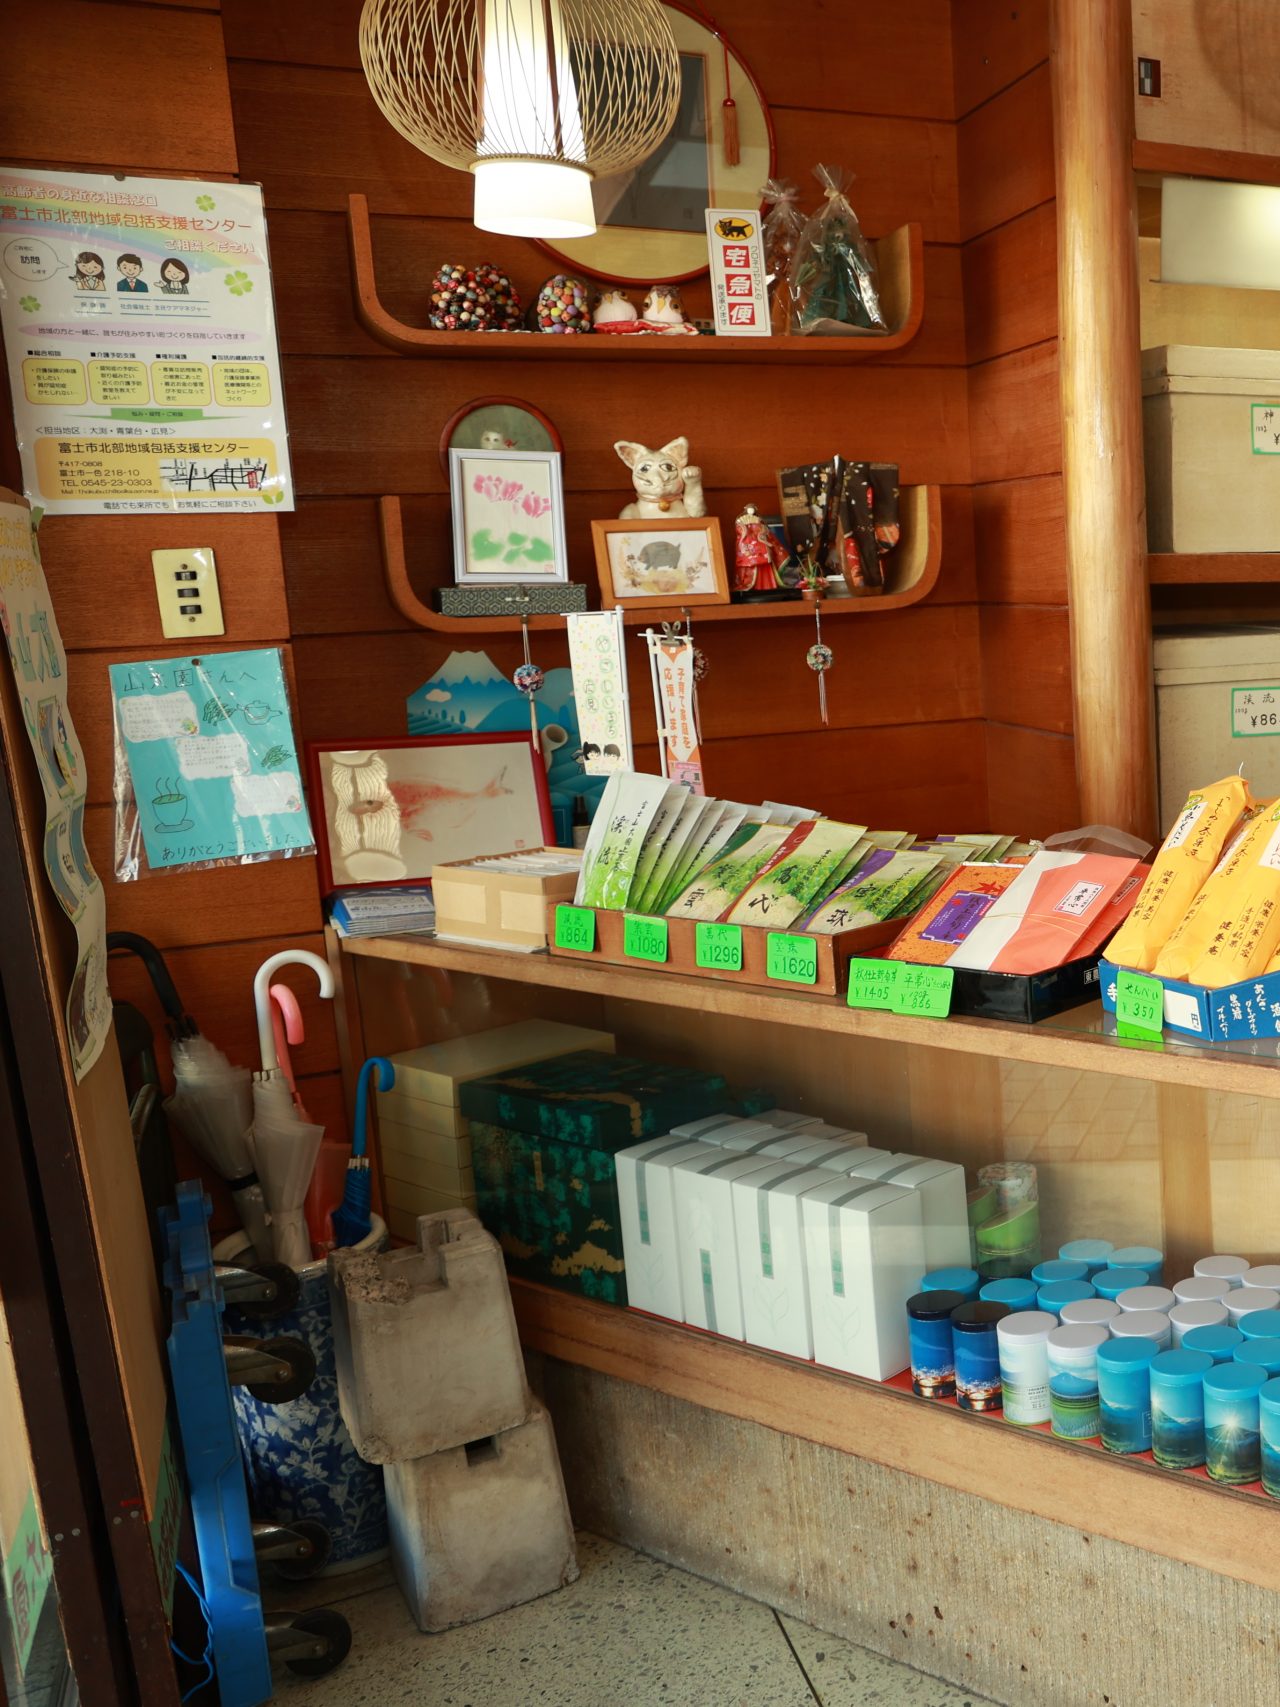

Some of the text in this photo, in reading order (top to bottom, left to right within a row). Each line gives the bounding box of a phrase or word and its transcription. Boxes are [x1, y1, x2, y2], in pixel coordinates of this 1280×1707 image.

[1, 206, 253, 233] 富士市北部地域包括支援センター
[164, 239, 256, 255] ご相談ください
[20, 255, 41, 266] 訪問
[751, 246, 762, 300] クロネコヤマトの
[725, 247, 753, 325] 宅急便
[58, 442, 250, 455] 富士市北部地域包括支援センター
[61, 479, 153, 487] TEL 0545-23-0303
[560, 927, 588, 945] ¥864
[630, 935, 666, 957] ¥1080
[702, 945, 740, 965] ¥1296
[774, 956, 816, 978] ¥1620
[855, 986, 890, 1001] ¥1405
[1124, 982, 1160, 1001] せんべい
